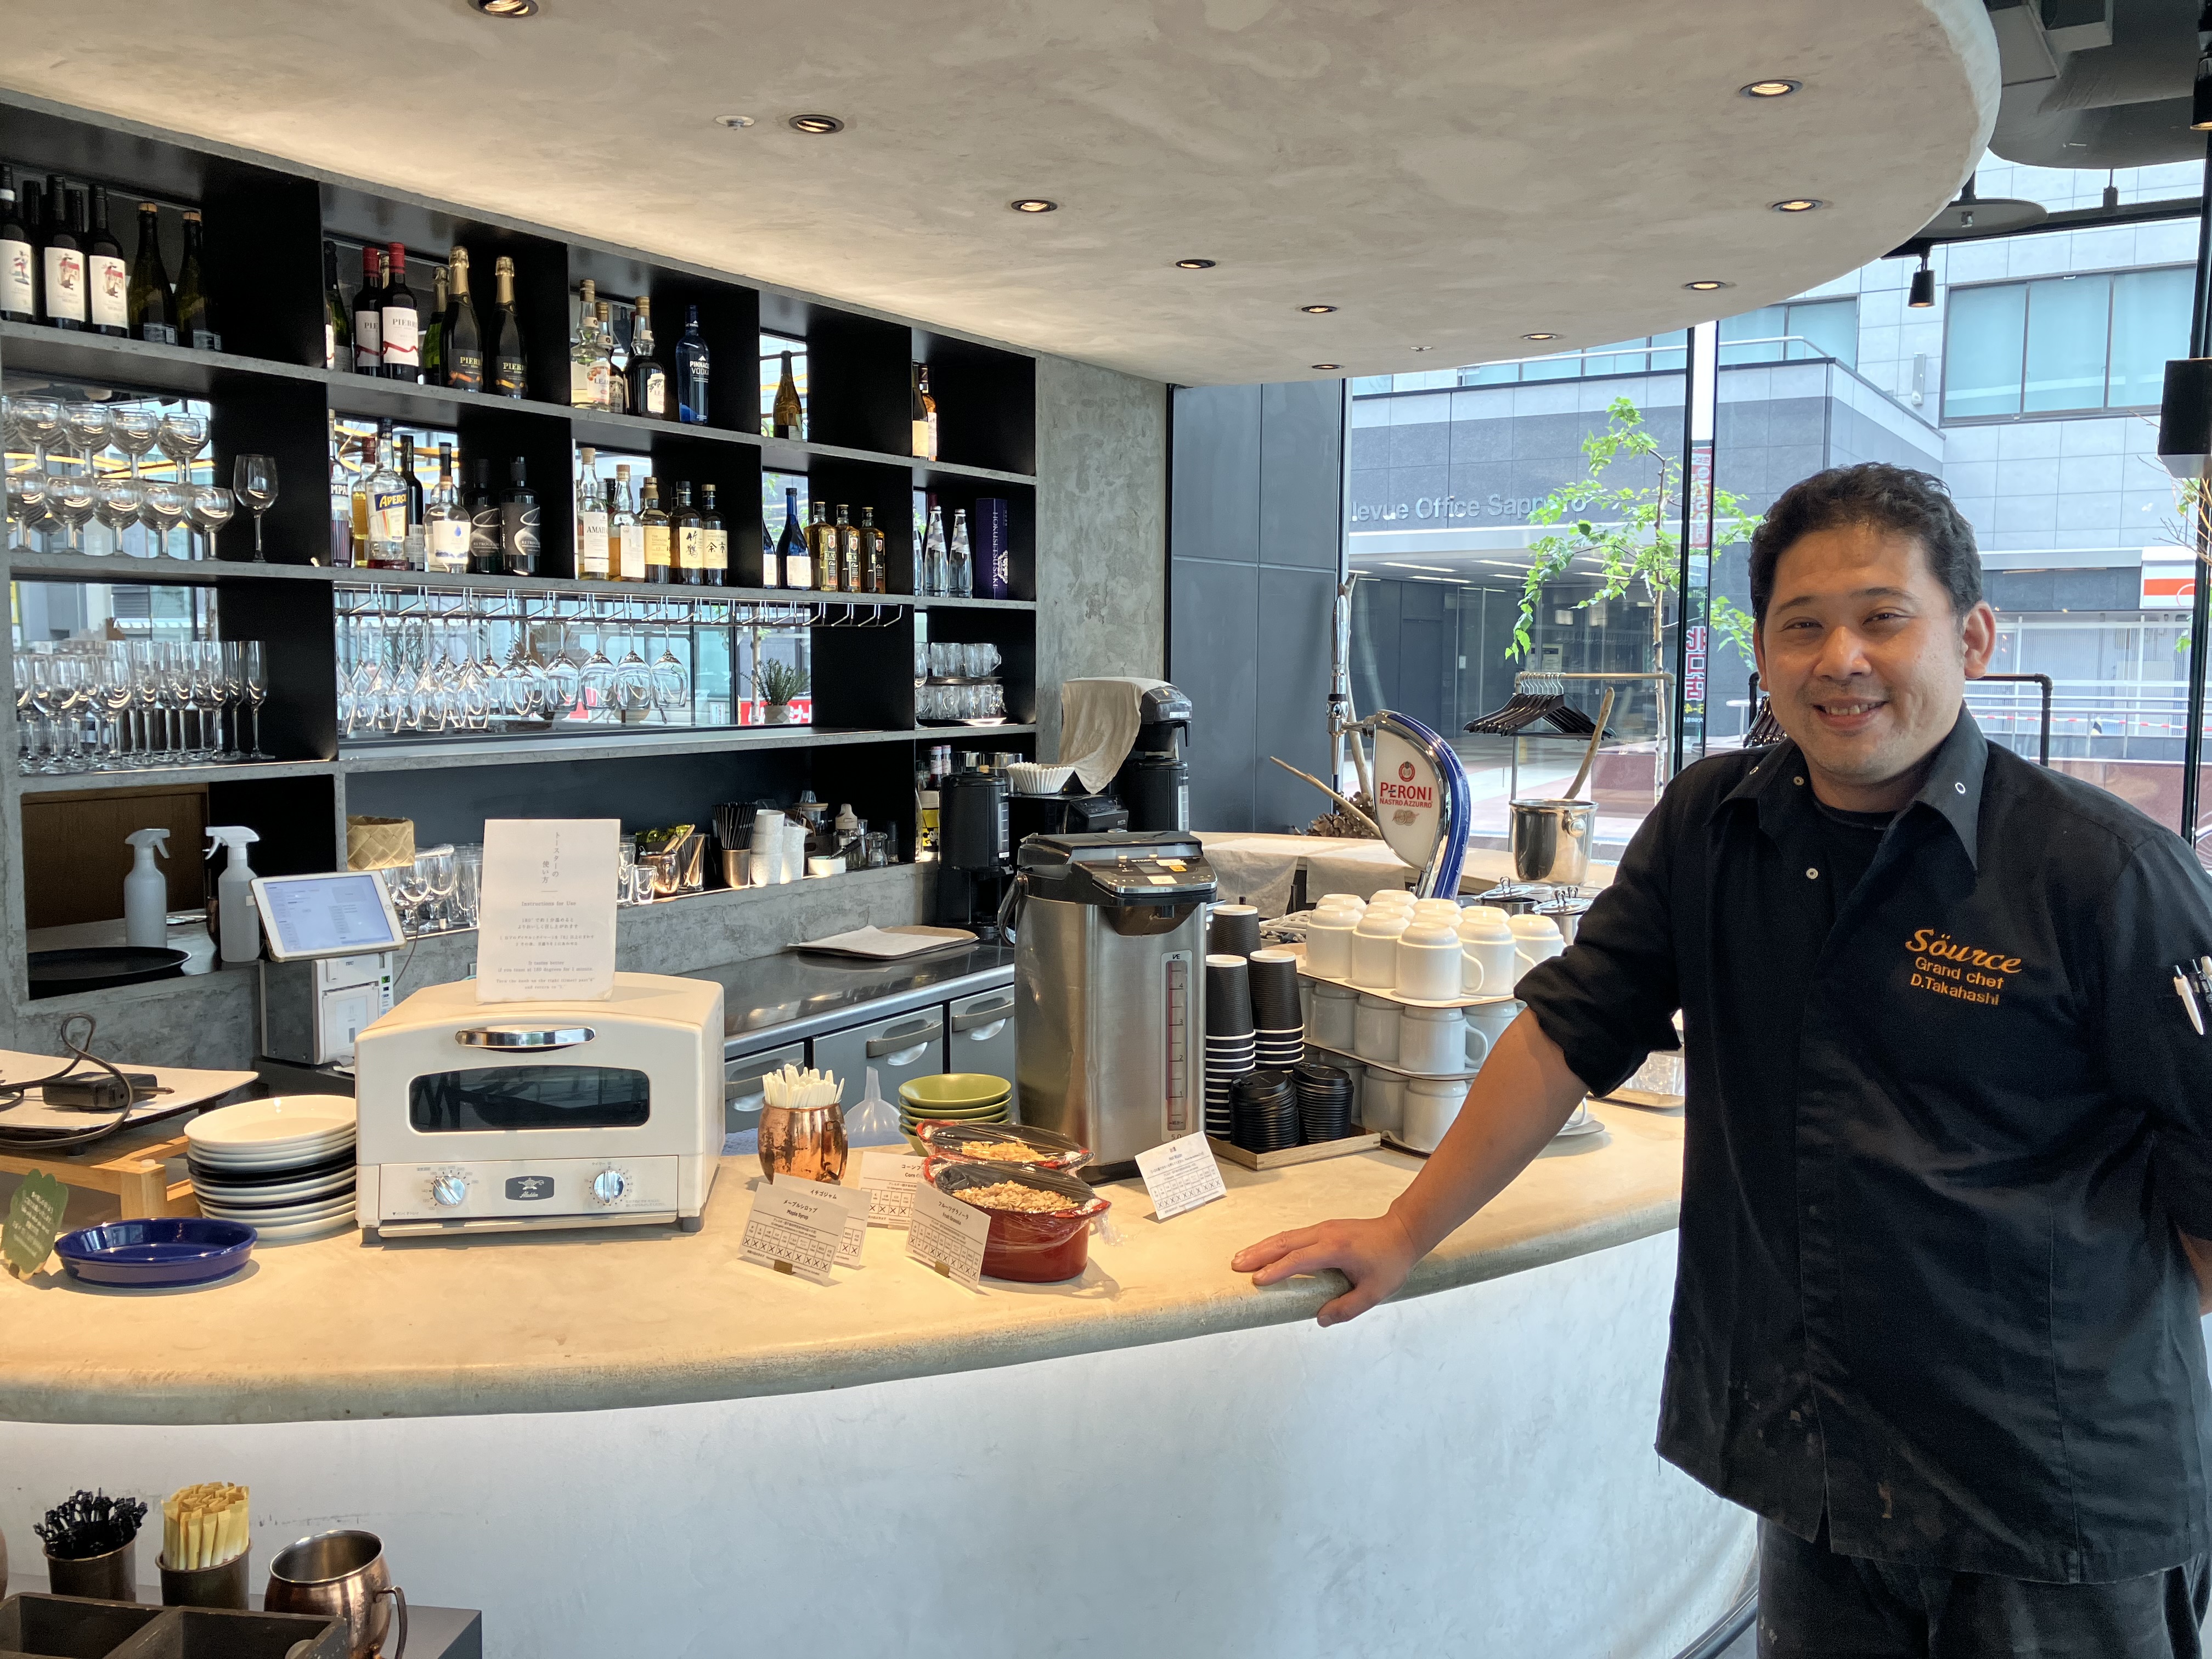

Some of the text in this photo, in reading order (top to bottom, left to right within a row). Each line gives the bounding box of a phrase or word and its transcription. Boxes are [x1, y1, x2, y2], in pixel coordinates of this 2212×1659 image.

[392, 319, 417, 328] PIERR
[1415, 495, 1481, 518] Office
[1487, 493, 1587, 520] Sappo
[706, 541, 726, 554] 余市
[1380, 782, 1432, 801] PERONI
[1379, 798, 1432, 809] NASTRO AZZURRO
[552, 832, 560, 877] トースターの
[1905, 928, 2022, 974] Söurce
[1915, 956, 2005, 989] Grand chef
[1910, 973, 2000, 1006] D.Takahashi
[810, 1189, 837, 1199] イチゴジャム
[786, 1209, 798, 1217] Maple
